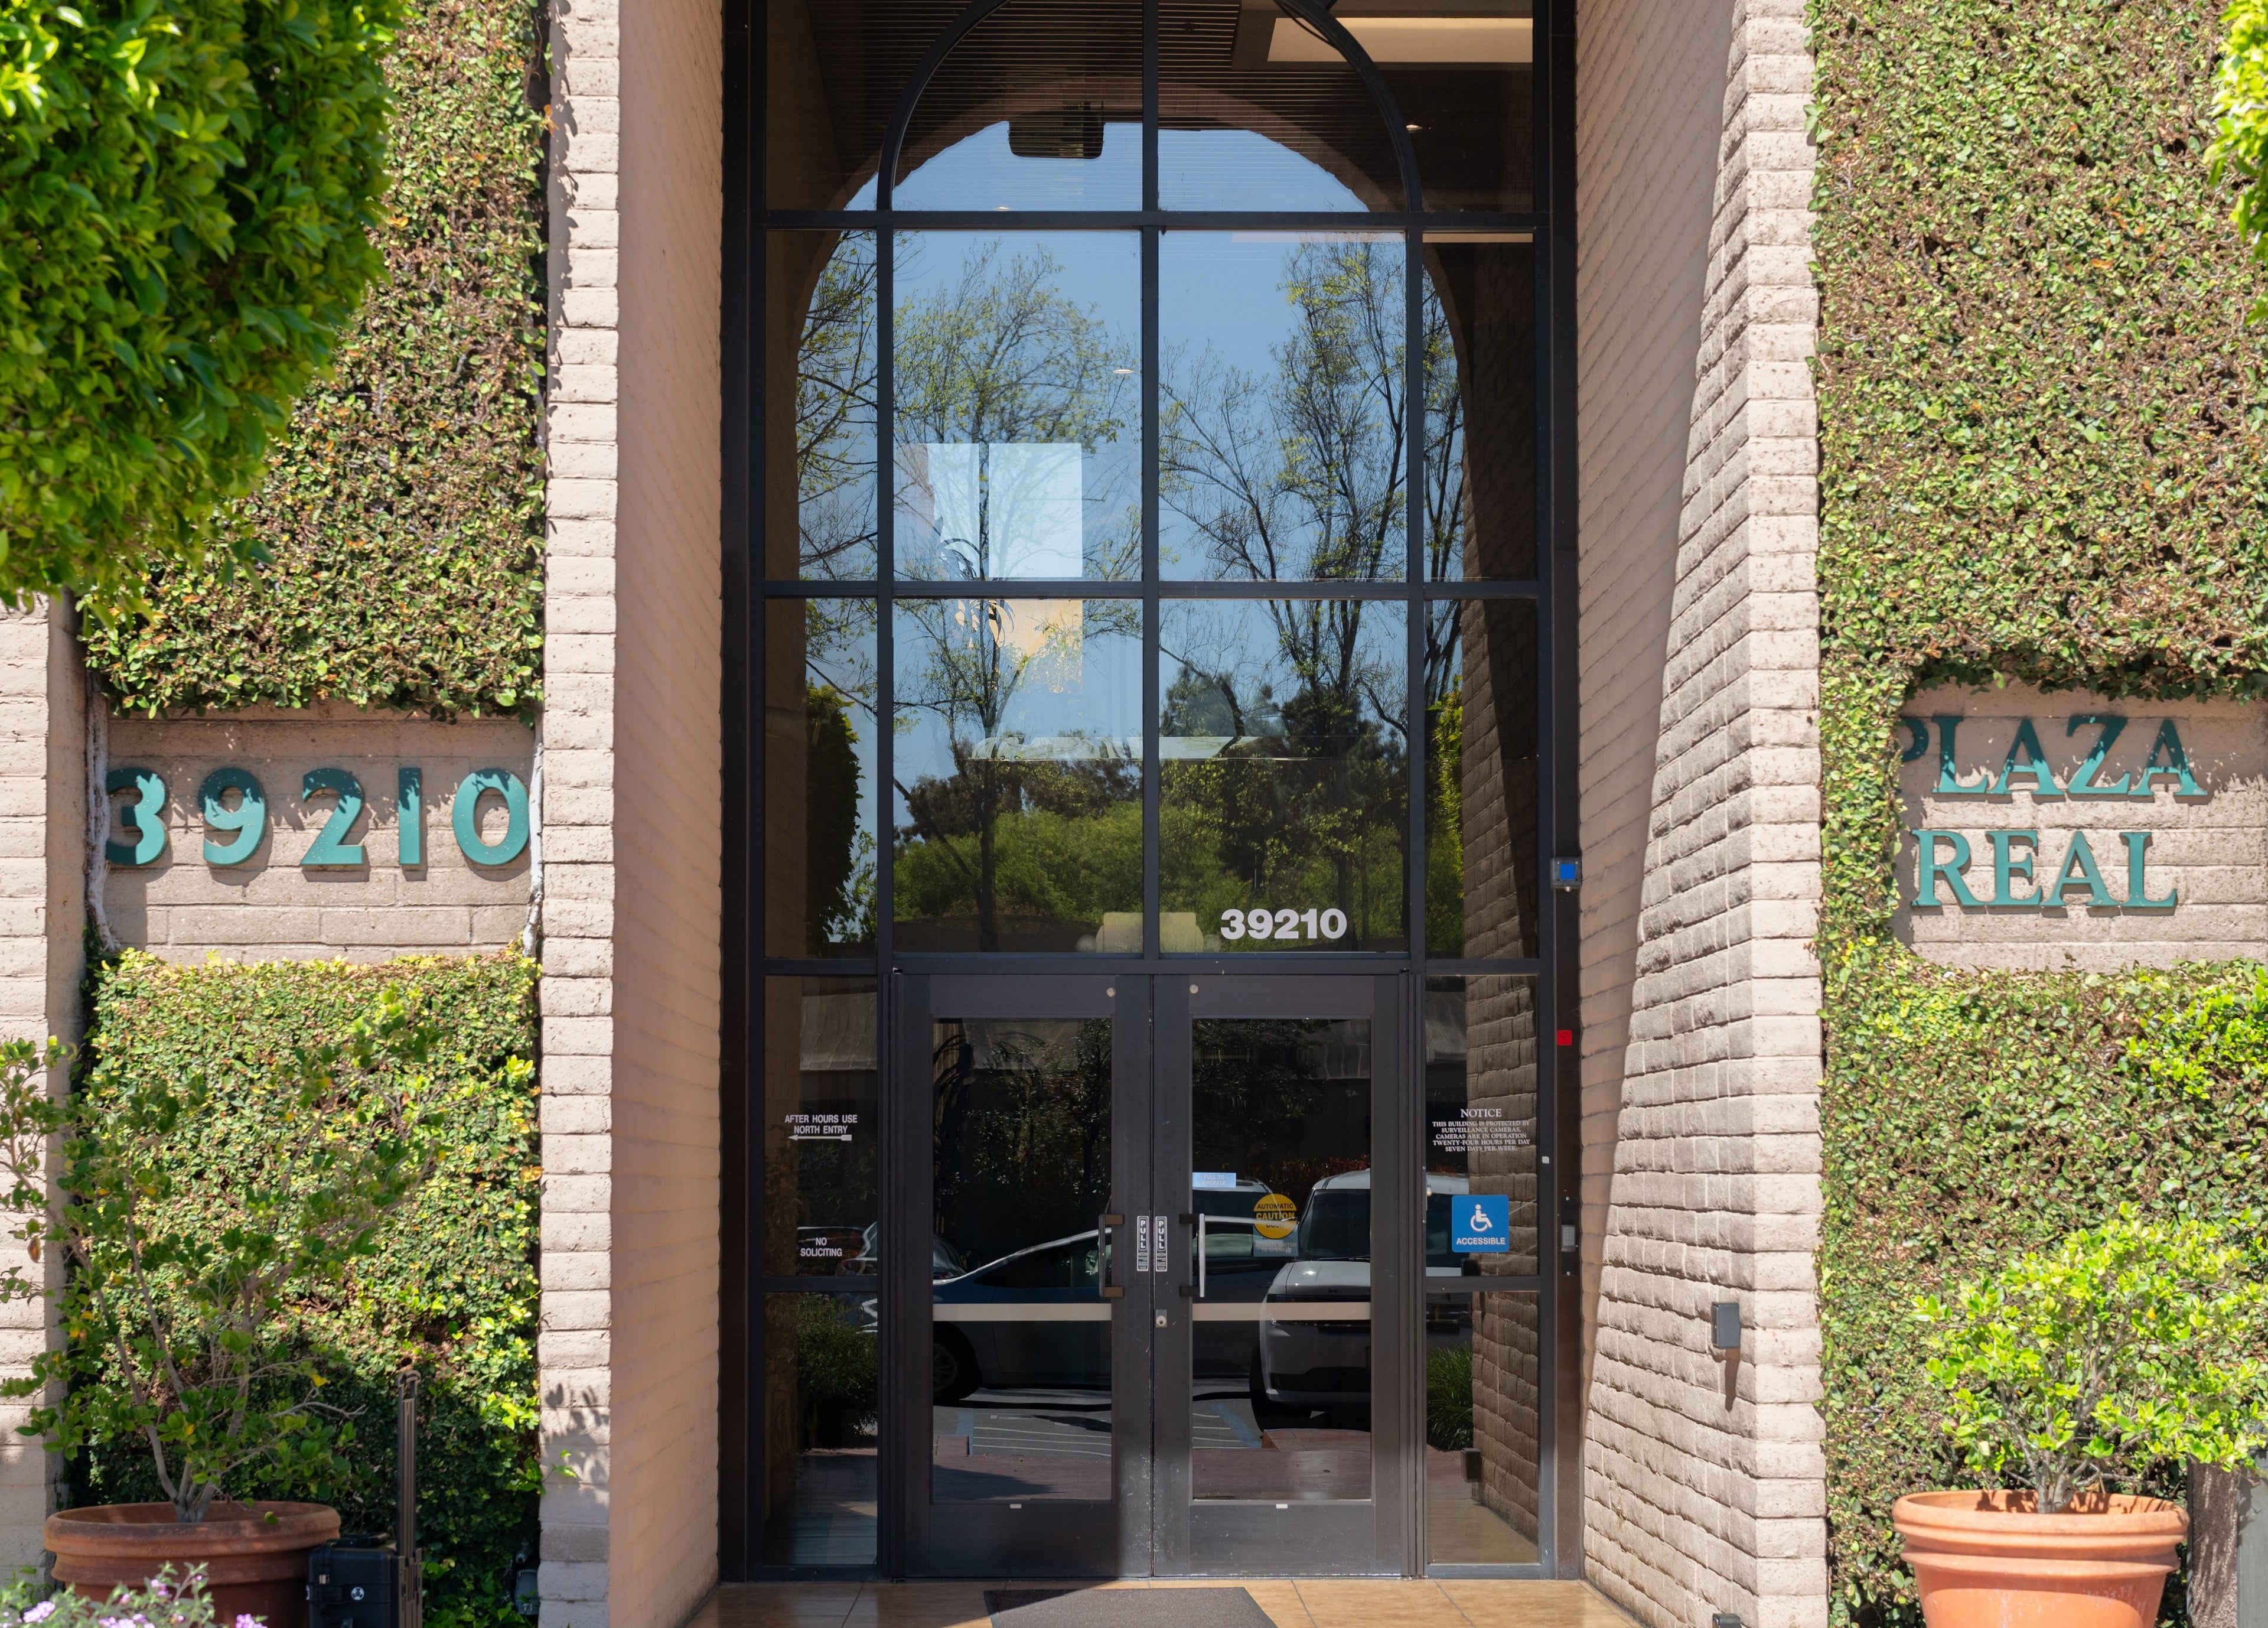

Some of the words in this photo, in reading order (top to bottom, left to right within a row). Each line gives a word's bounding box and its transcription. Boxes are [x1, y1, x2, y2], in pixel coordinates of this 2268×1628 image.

[105, 767, 529, 866] 39210
[1911, 829, 2178, 908] REAL
[1220, 908, 1347, 940] 39210
[1460, 1108, 1502, 1118] NOTICE
[784, 1114, 809, 1123] AFTER
[812, 1114, 839, 1123] HOURS
[842, 1114, 858, 1123] USE
[794, 1125, 820, 1134] NORTH
[823, 1125, 848, 1134] ENTRY
[816, 1237, 827, 1246] NO
[800, 1248, 842, 1257] SOLICITING
